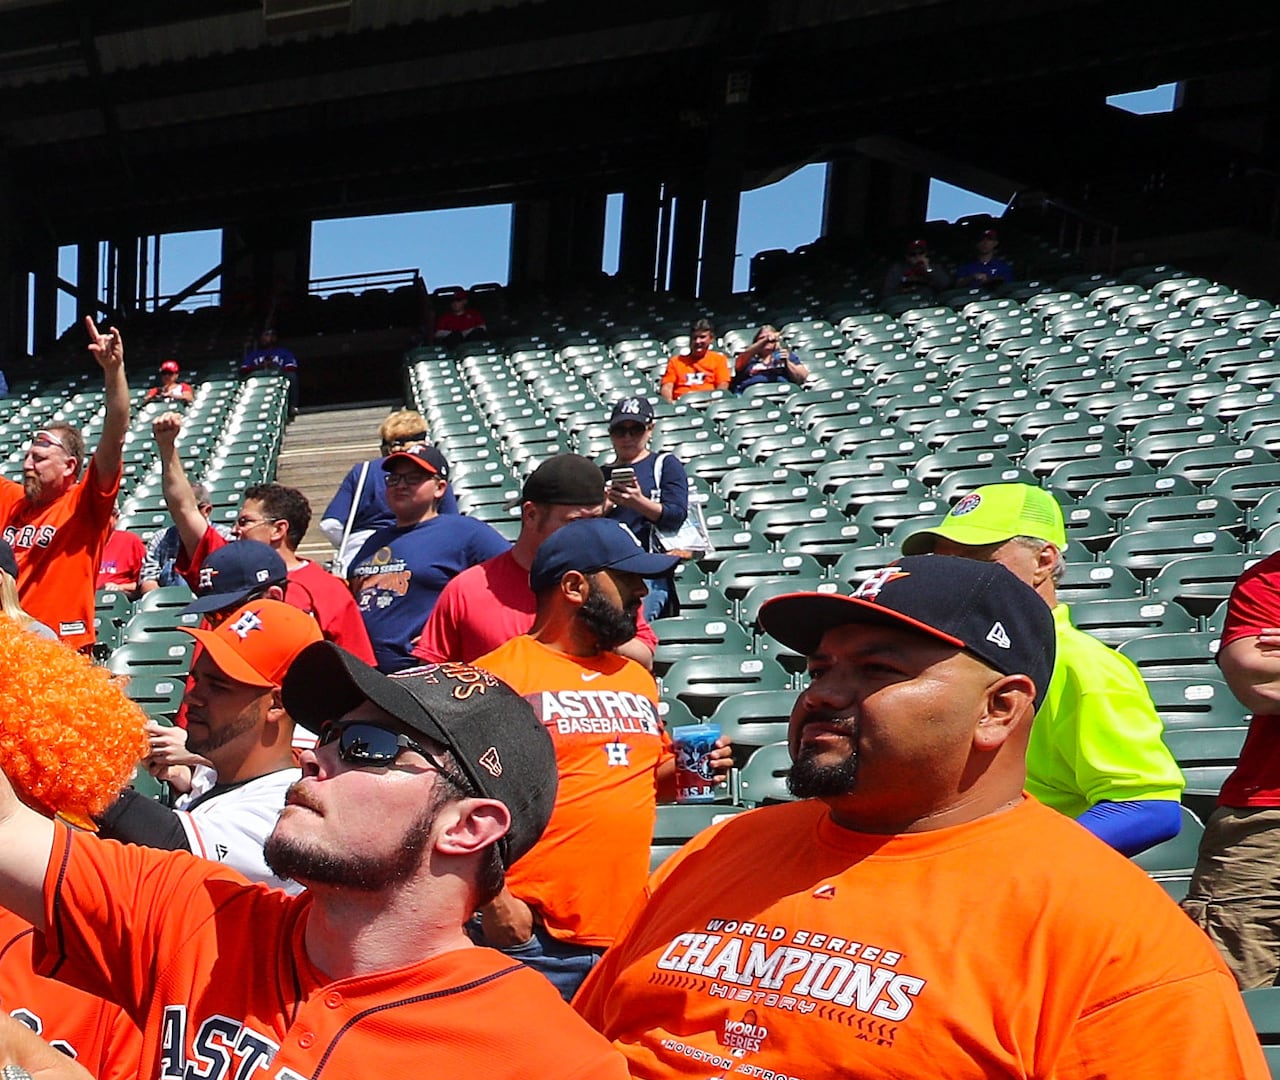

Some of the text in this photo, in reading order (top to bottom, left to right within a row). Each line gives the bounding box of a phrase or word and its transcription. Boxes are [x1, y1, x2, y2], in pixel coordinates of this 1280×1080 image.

[542, 690, 658, 727] ASTROS
[557, 717, 642, 734] BASEBALL
[605, 743, 630, 767] H
[707, 919, 902, 969] WORLD SERIES
[657, 931, 927, 1022] CHAMPIONS
[708, 982, 816, 1014] HISTORY
[722, 1033, 761, 1051] SERIES
[724, 1018, 768, 1039] WORLD
[664, 1039, 733, 1071] HOUSTON
